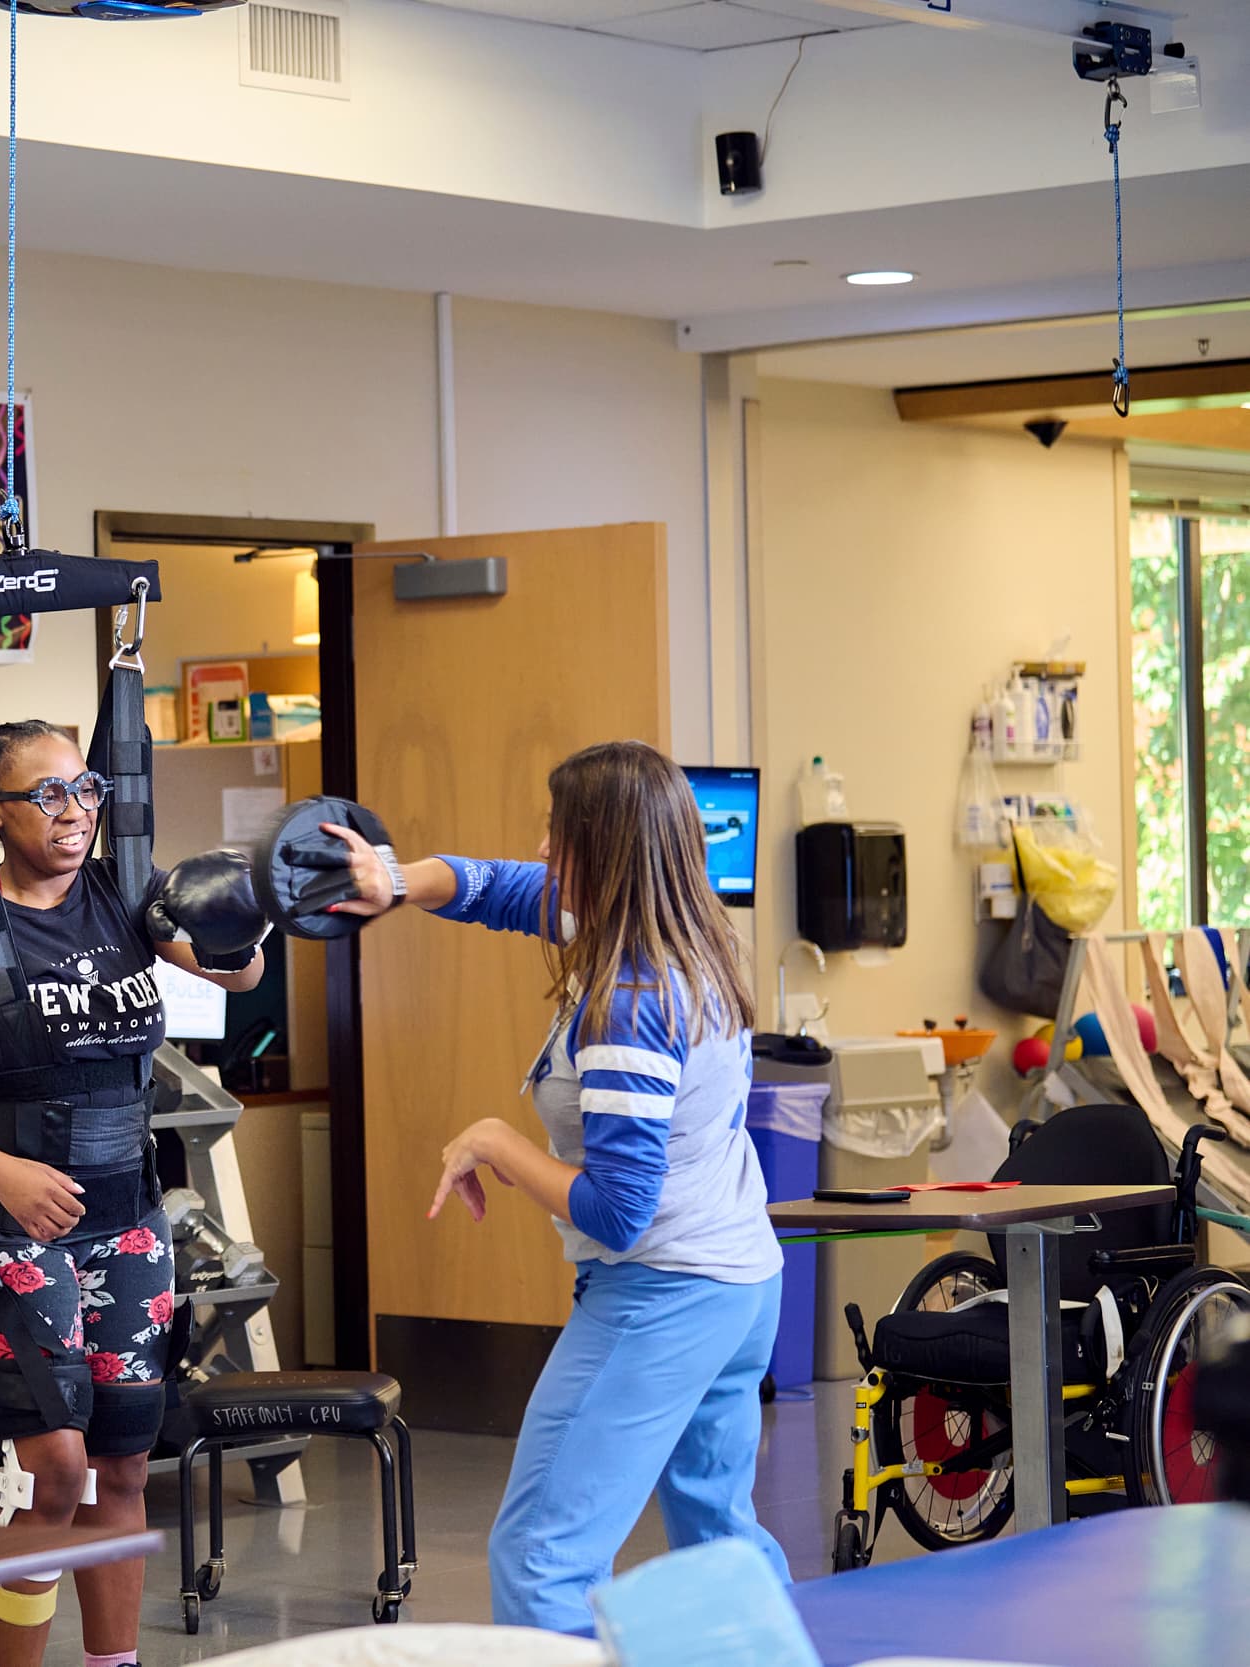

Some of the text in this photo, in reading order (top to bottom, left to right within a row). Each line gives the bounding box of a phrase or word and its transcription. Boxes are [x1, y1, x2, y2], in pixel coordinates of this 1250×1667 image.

[213, 1406, 256, 1427] STAFF
[258, 1405, 294, 1425] ONLY
[310, 1406, 342, 1425] CRU
